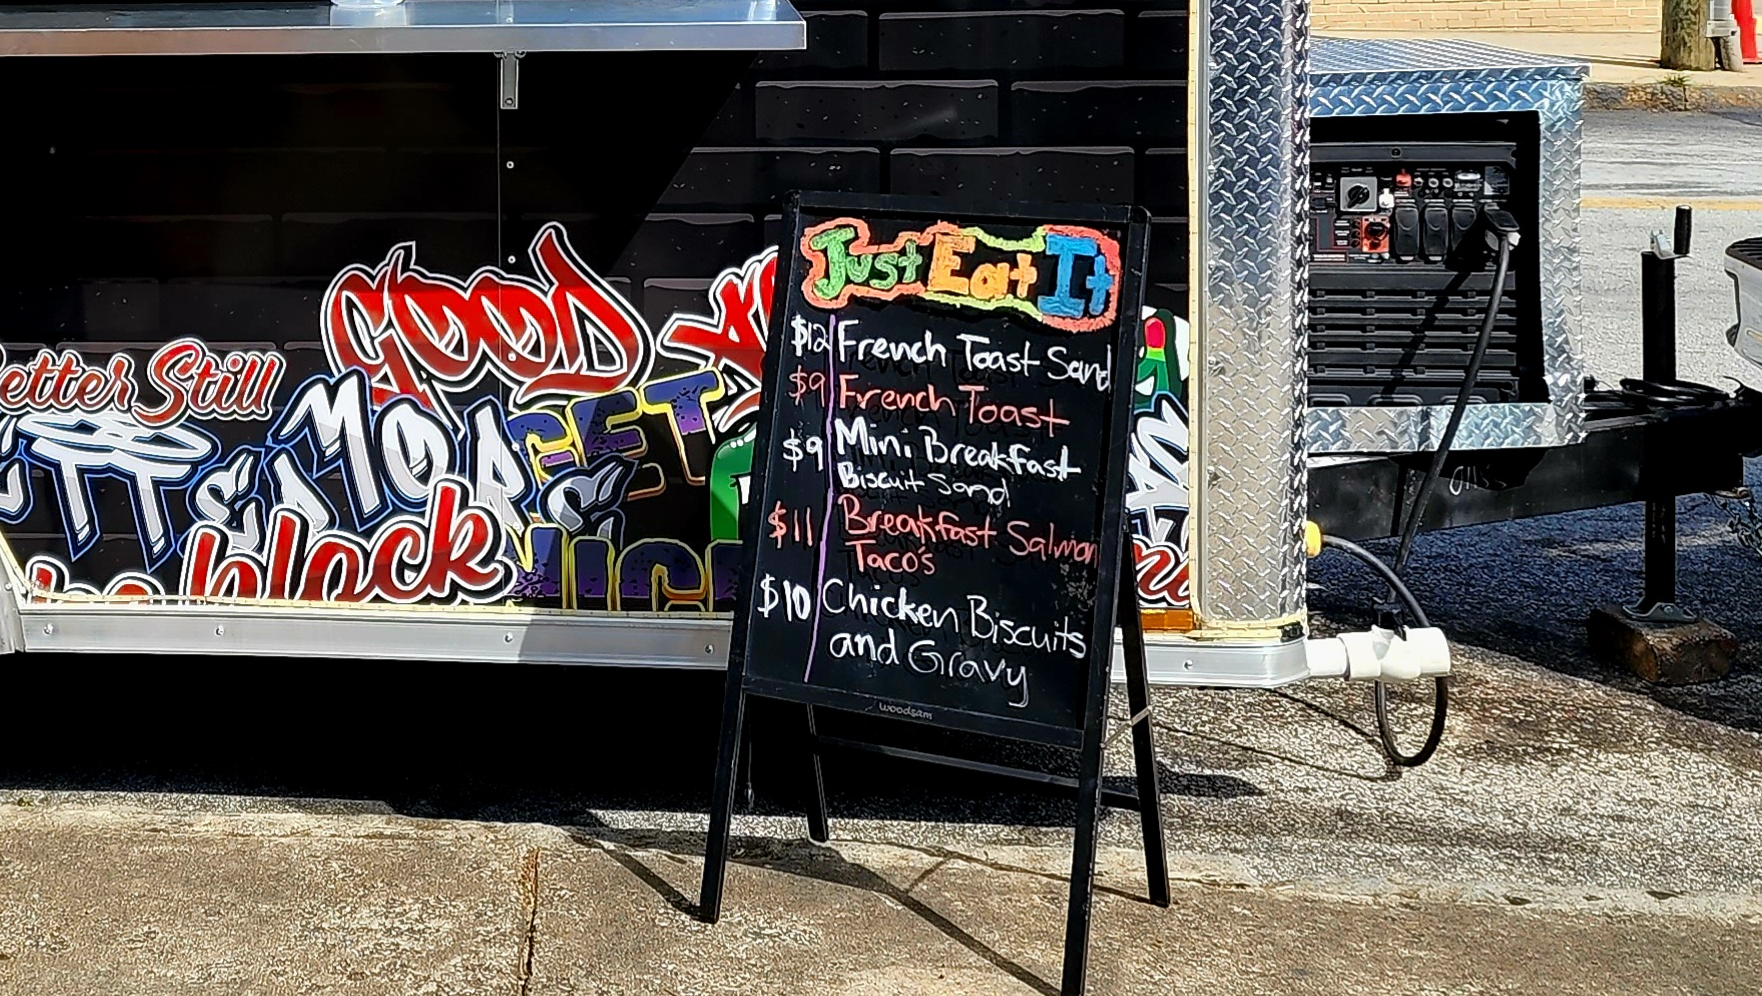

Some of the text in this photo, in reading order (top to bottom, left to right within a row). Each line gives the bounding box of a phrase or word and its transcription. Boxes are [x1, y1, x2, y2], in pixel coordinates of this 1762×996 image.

[809, 226, 1115, 318] Just Eat It
[131, 336, 287, 426] Still
[791, 315, 831, 357] $12
[838, 320, 947, 365] French
[956, 333, 1041, 379] Toast
[1047, 342, 1112, 392] Sand
[789, 365, 1070, 438] $9 French Toast
[783, 416, 1082, 482] $9 Mini Breakfast
[839, 460, 925, 492] Biscuit
[180, 478, 517, 606] block
[768, 494, 1099, 570] $11 Breakfast Salmon
[845, 538, 936, 575] Taco's
[758, 573, 1087, 658] $10 Chicken Biscuits
[829, 628, 1030, 708] and Gravy
[879, 701, 933, 721] woodsam
